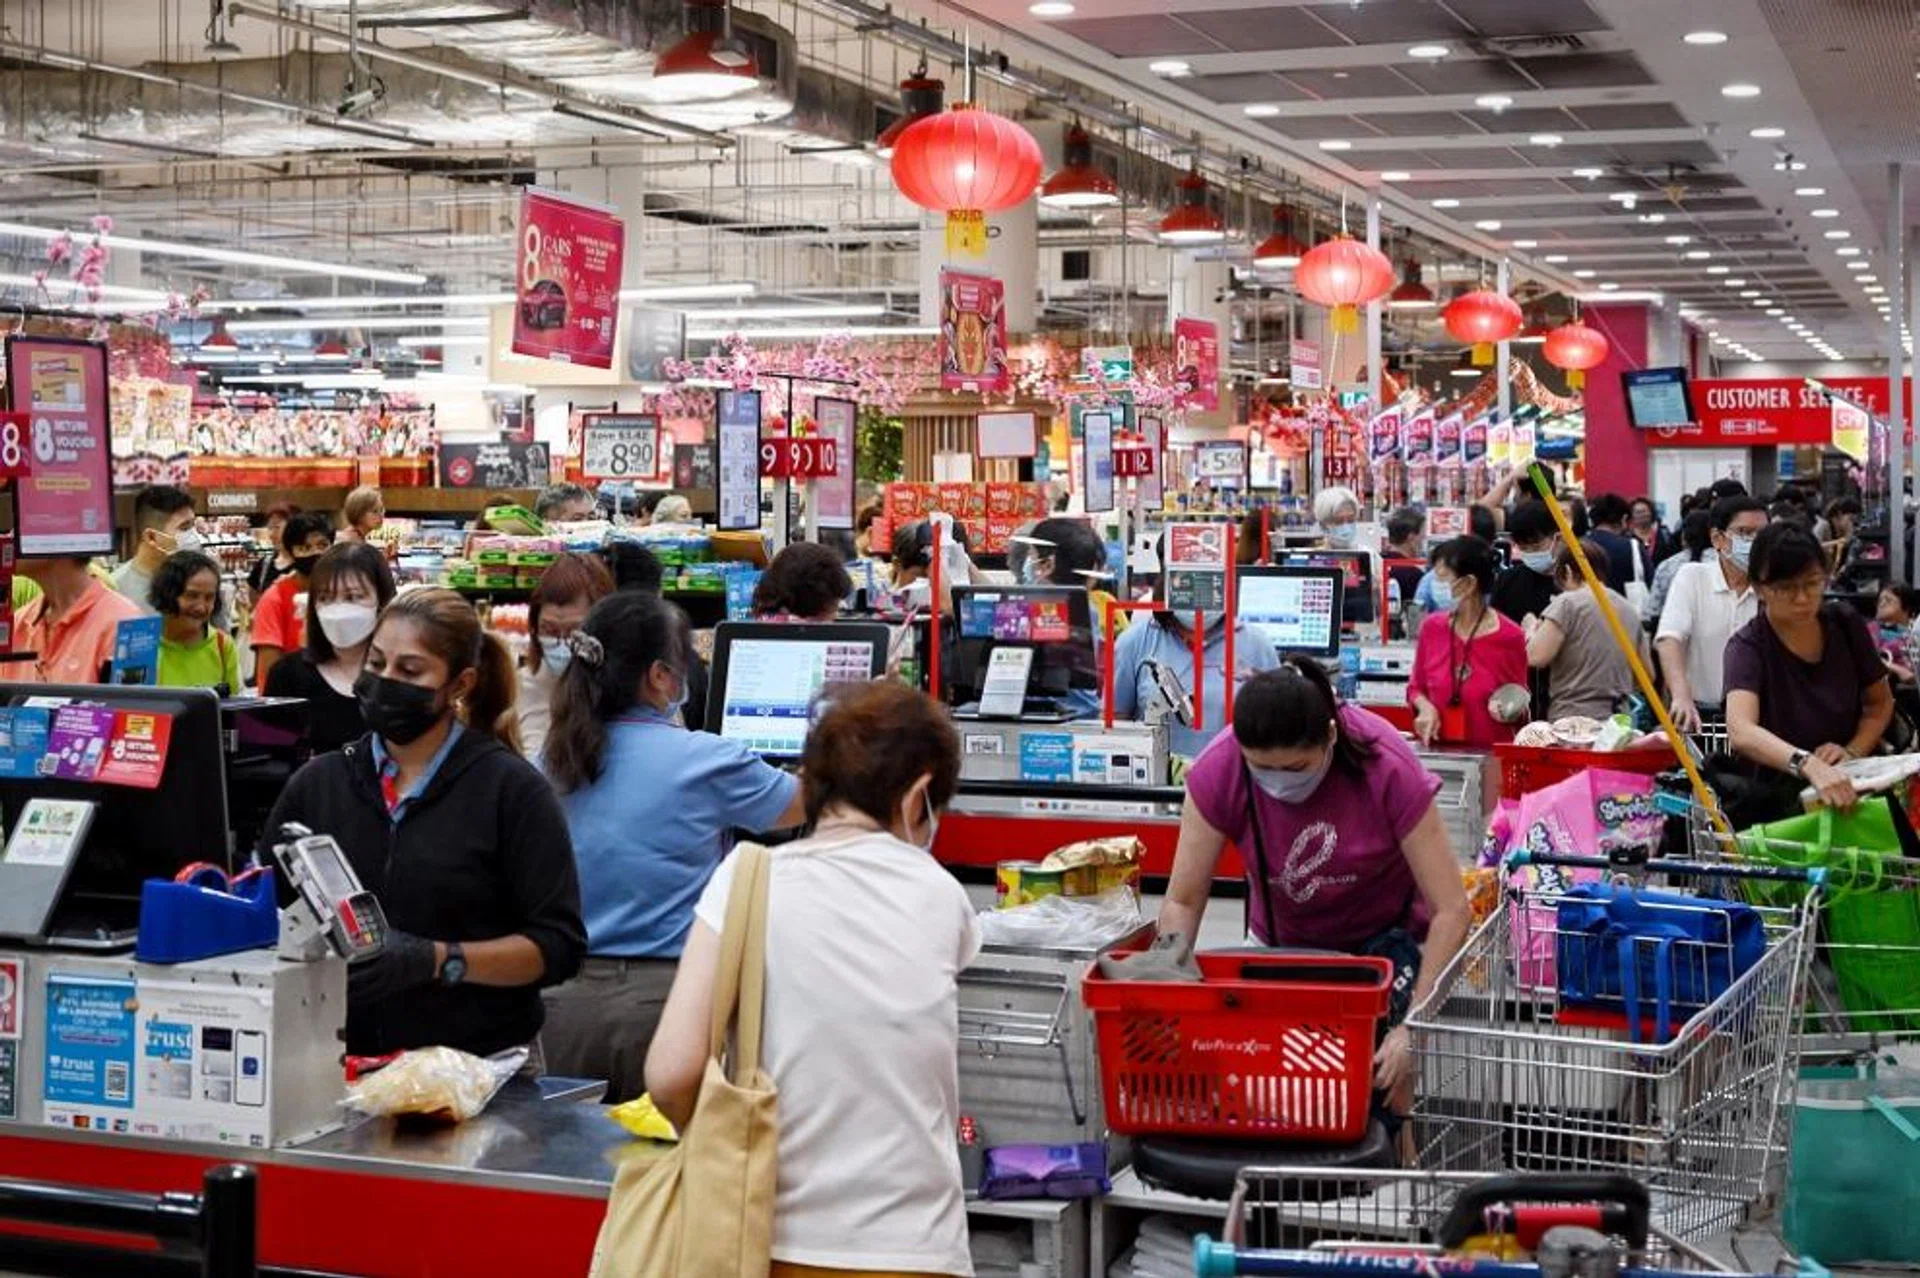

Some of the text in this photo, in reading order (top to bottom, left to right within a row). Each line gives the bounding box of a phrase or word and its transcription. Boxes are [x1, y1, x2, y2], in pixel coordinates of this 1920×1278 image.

[1706, 387, 1791, 409] CUSTOMER
[2, 422, 20, 467] 8
[761, 444, 776, 472] 9
[62, 1057, 94, 1071] trust
